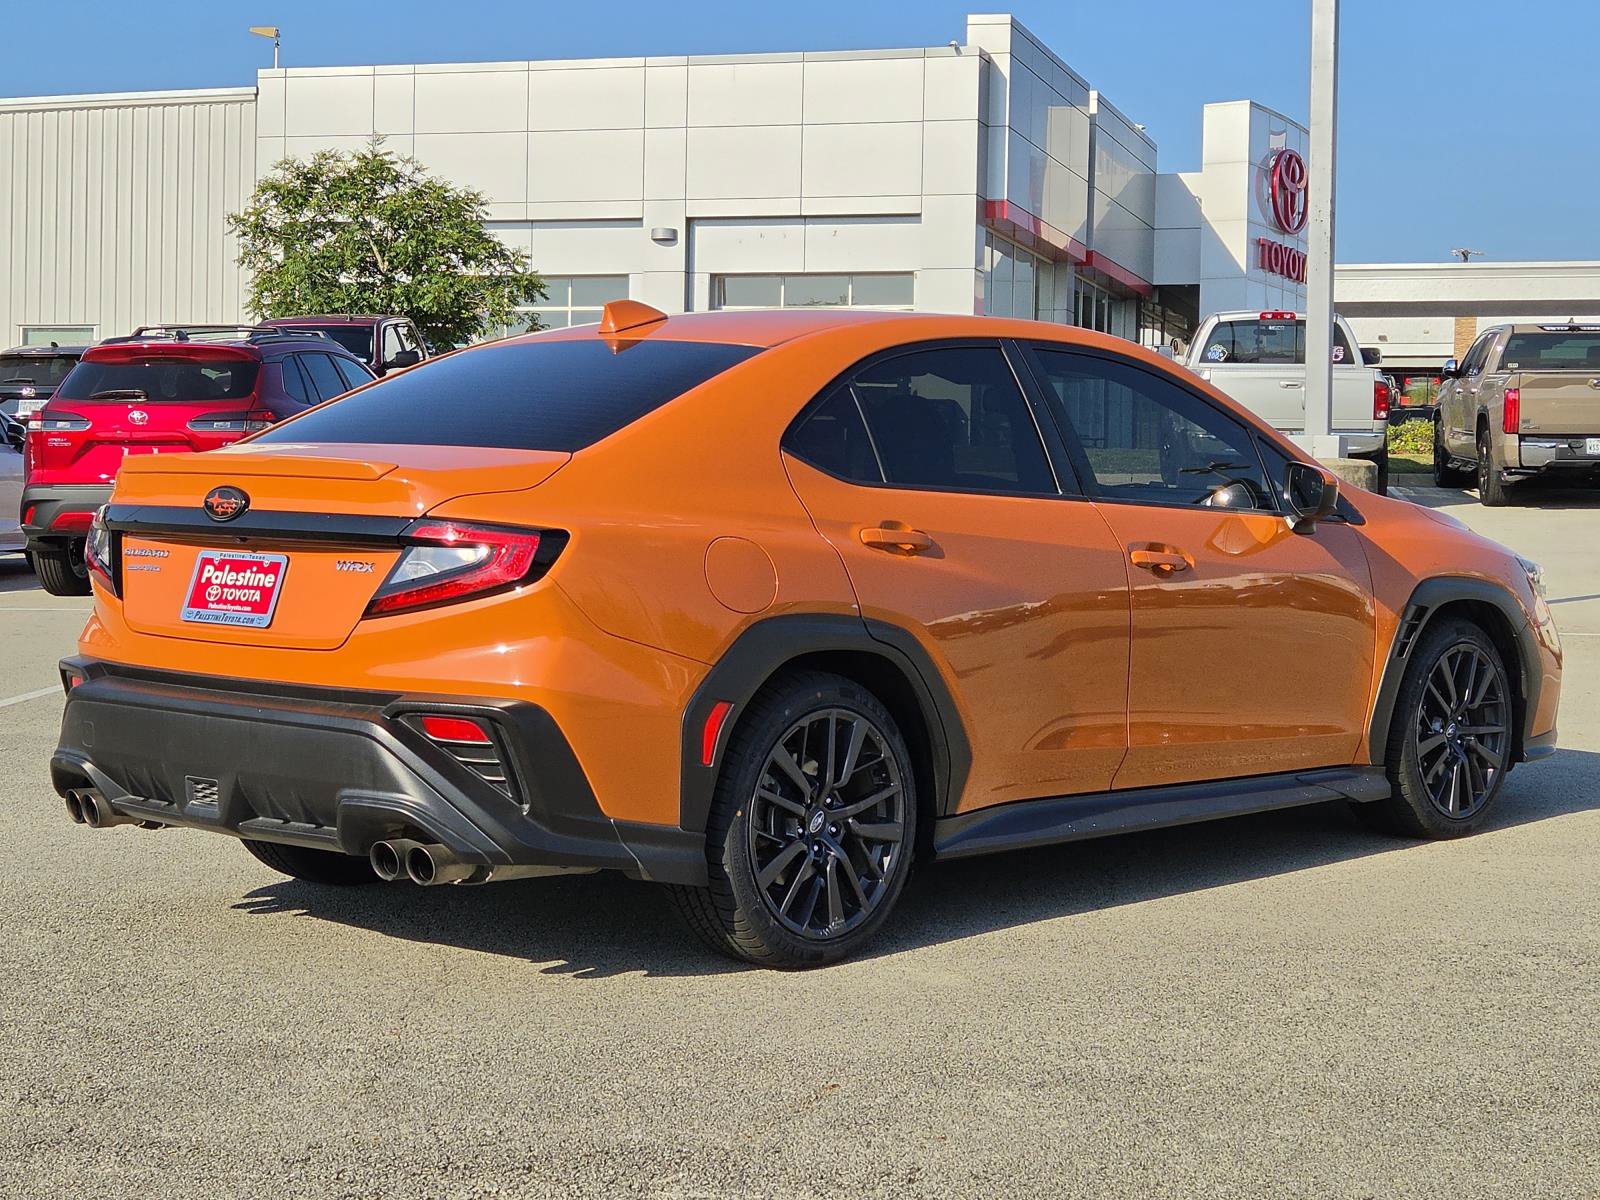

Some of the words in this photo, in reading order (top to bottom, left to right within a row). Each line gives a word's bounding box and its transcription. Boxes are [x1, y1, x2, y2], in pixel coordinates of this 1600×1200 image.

[1258, 237, 1307, 284] TOYOT
[336, 560, 375, 573] WRX
[201, 564, 276, 588] Palestine
[222, 587, 261, 602] TOYOTA
[208, 602, 252, 611] PalestineToyota.com
